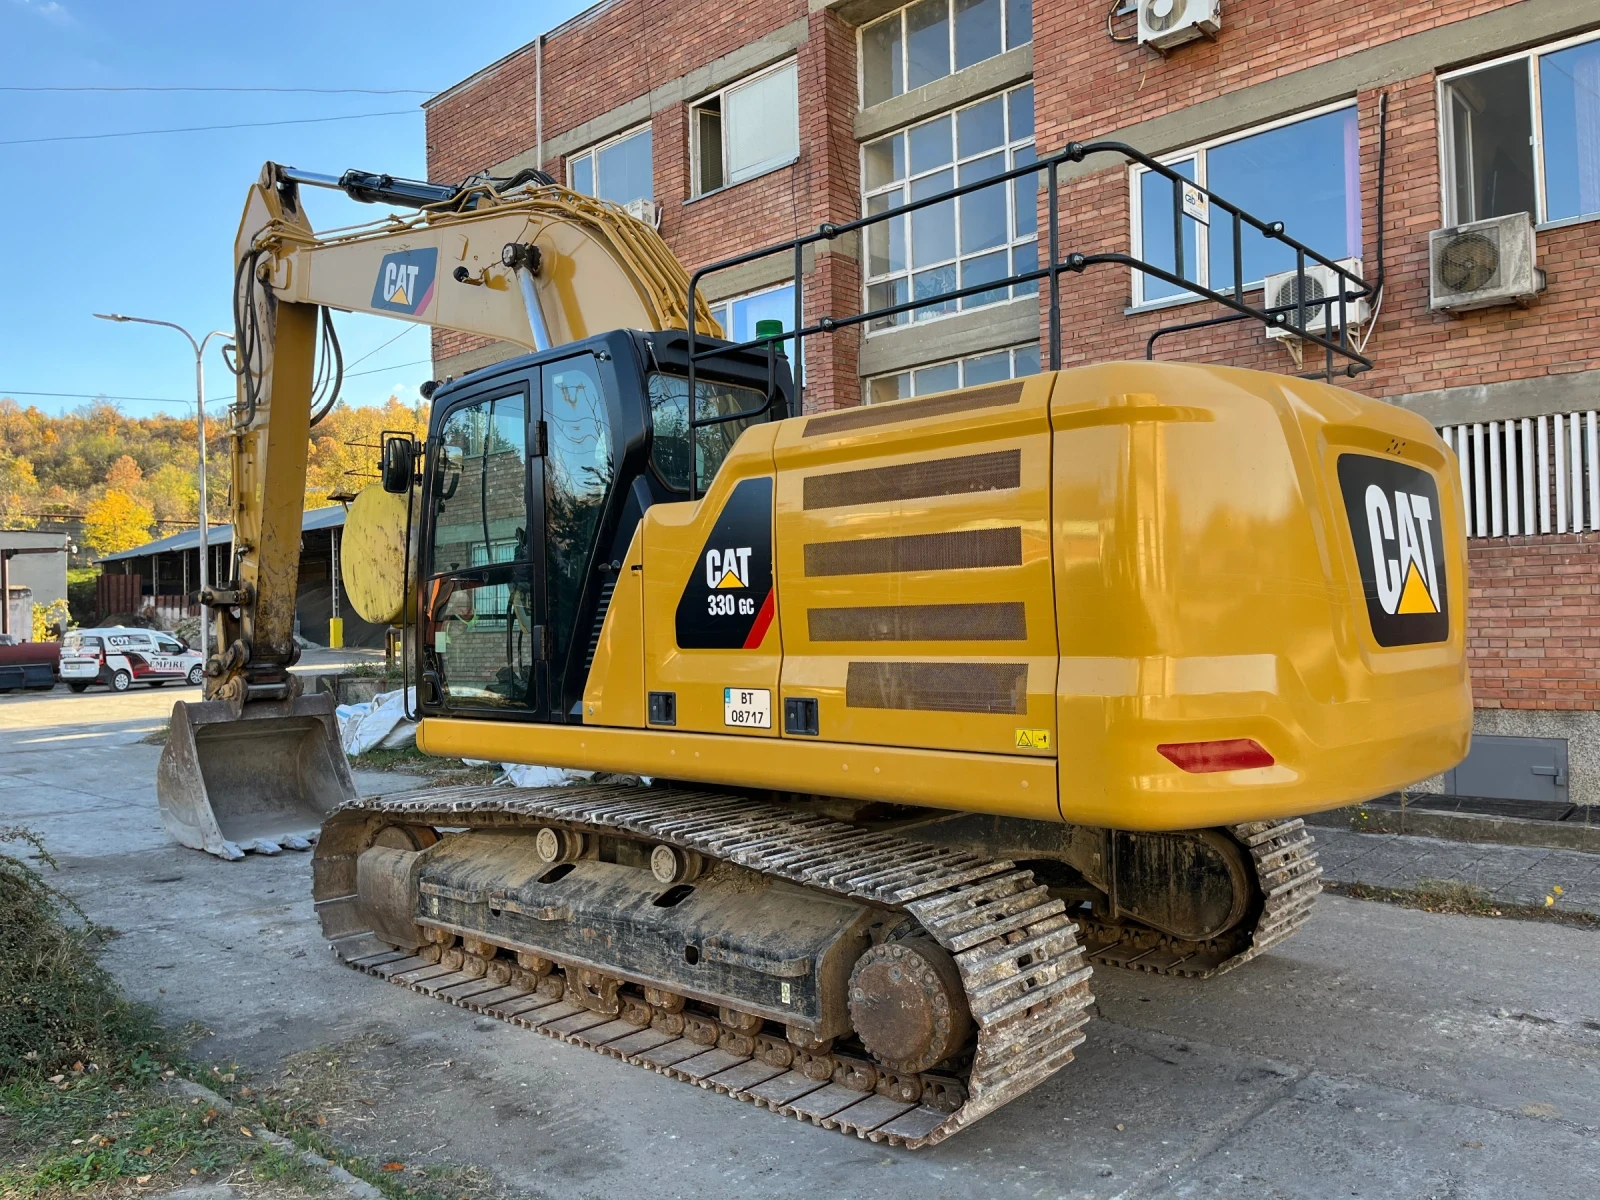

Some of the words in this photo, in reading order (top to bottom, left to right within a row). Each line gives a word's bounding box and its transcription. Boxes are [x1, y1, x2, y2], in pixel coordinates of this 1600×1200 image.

[383, 262, 419, 306] CAT
[1365, 484, 1441, 615] CAT
[706, 547, 752, 589] CAT
[707, 594, 735, 616] 330
[738, 598, 755, 615] GC
[110, 636, 130, 645] COT
[150, 660, 185, 668] EMPIRE
[741, 692, 754, 705] BT
[731, 710, 764, 724] 08717
